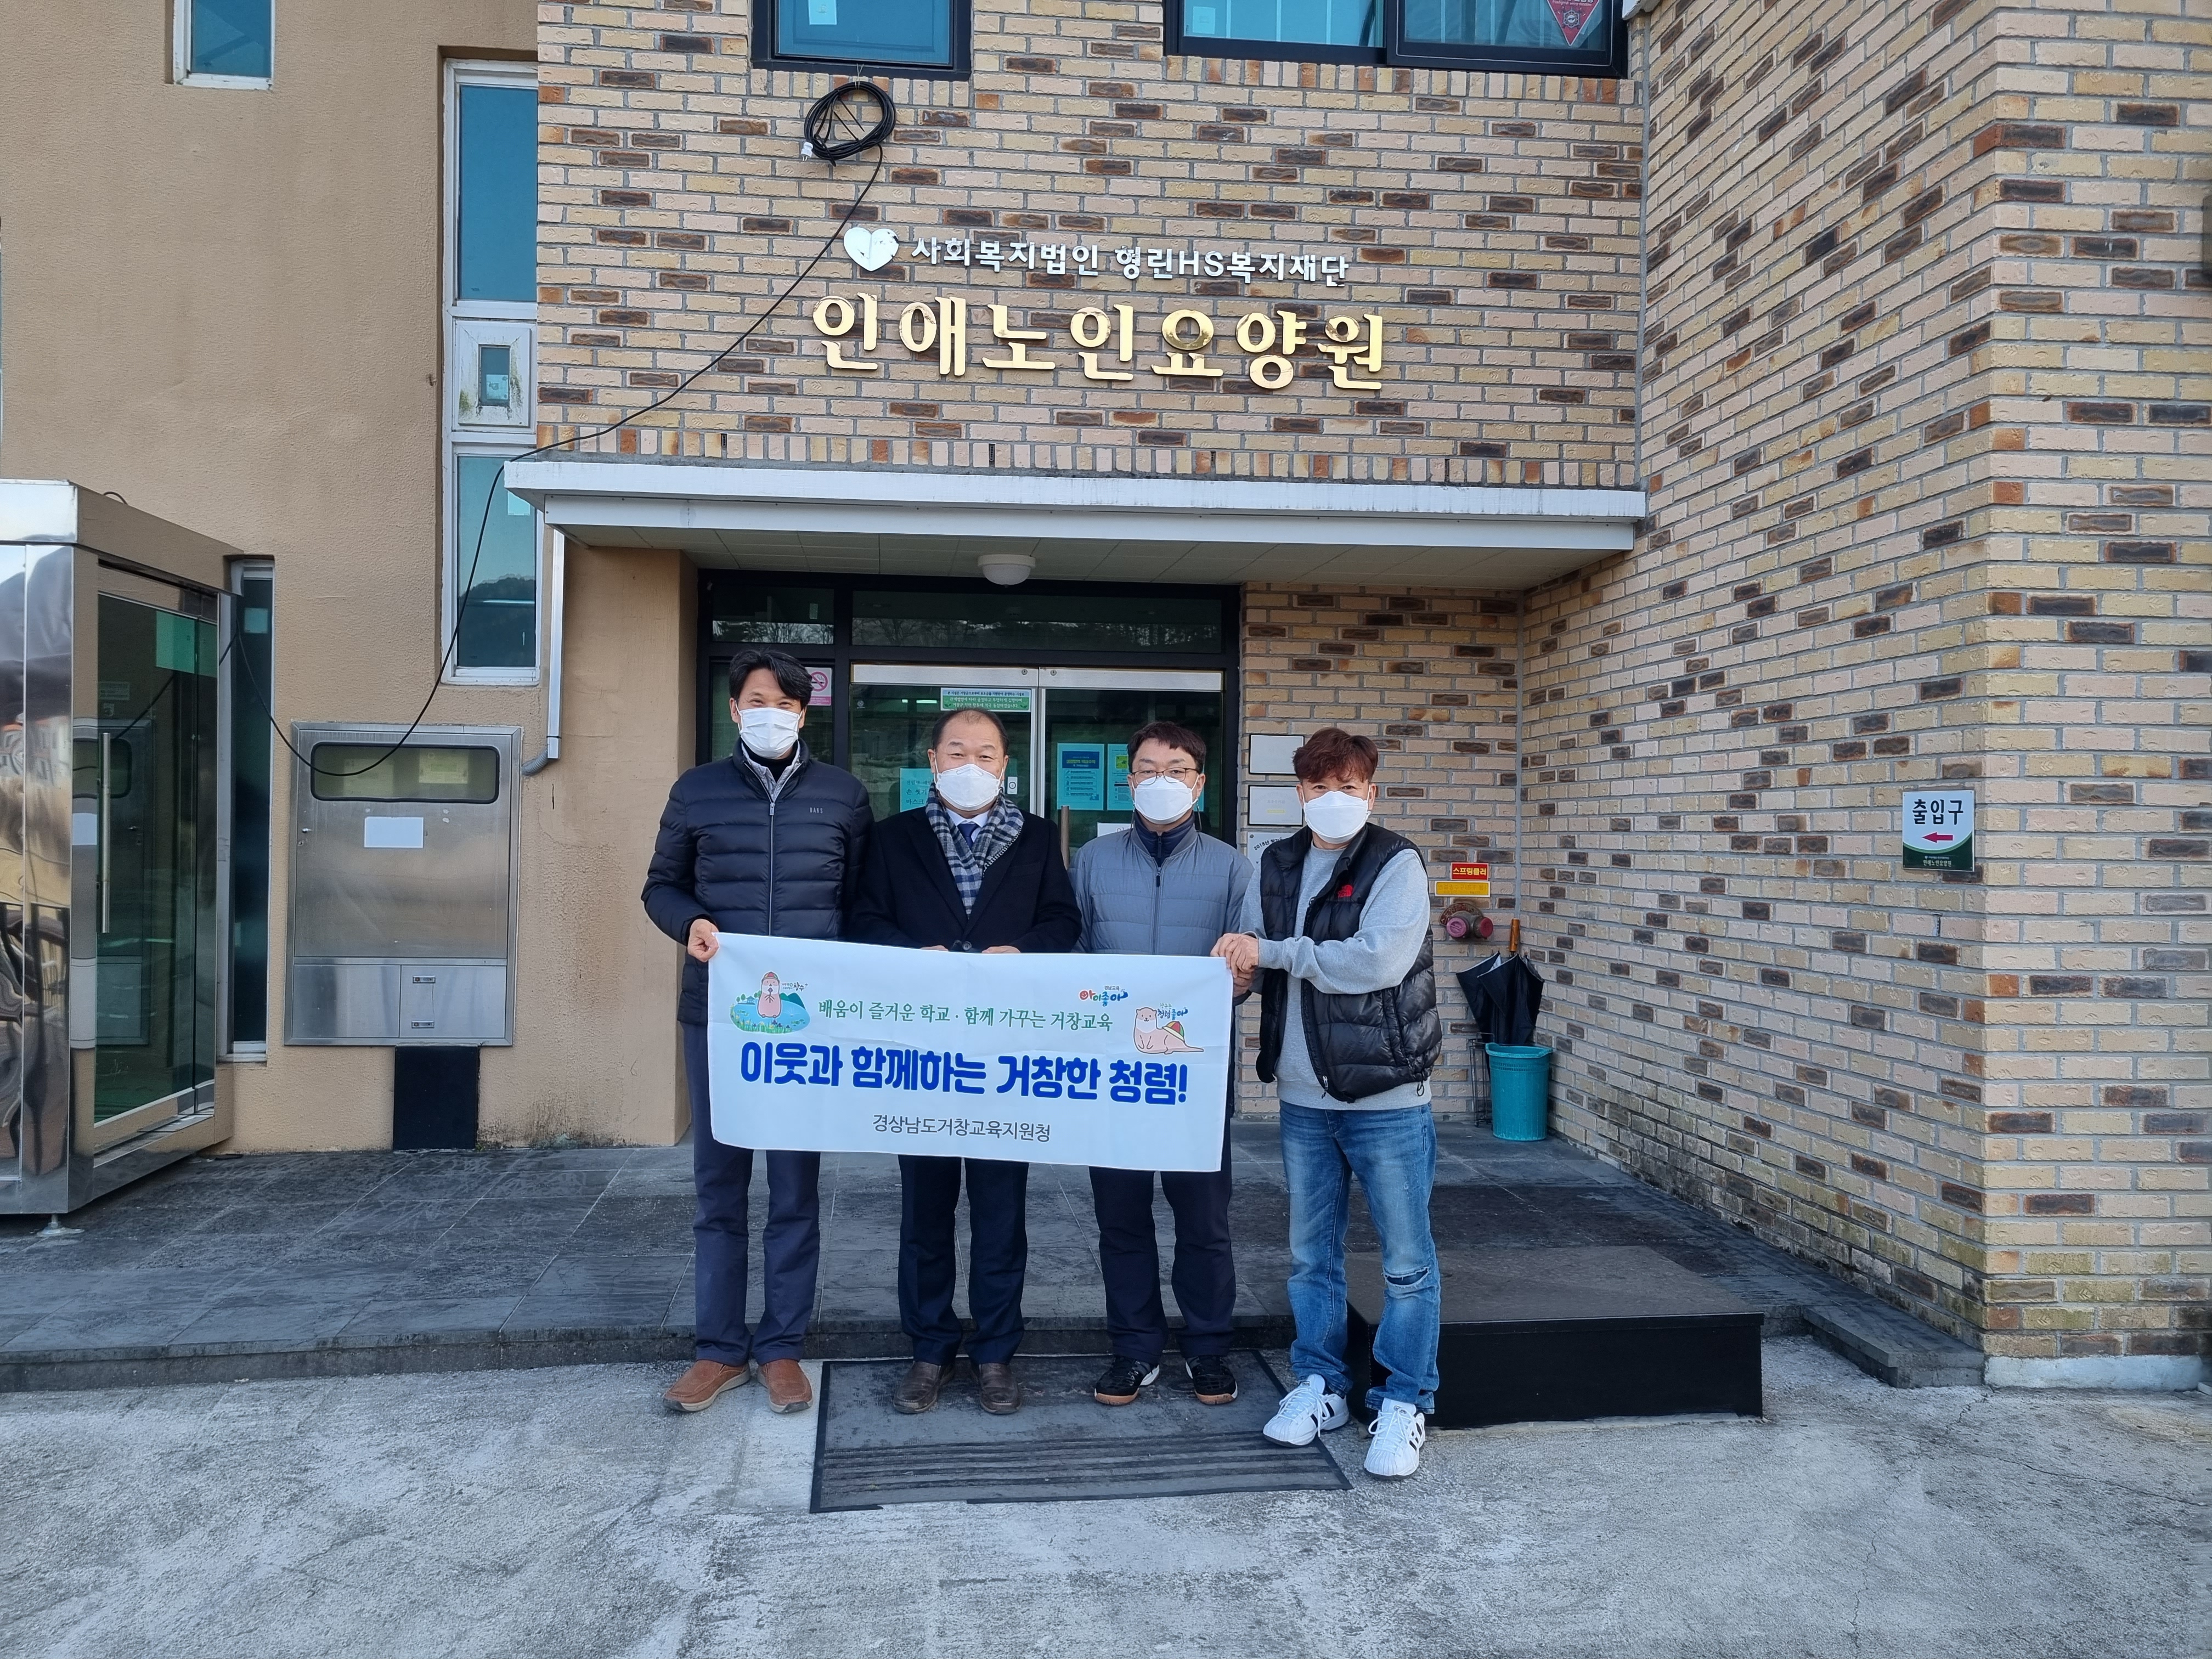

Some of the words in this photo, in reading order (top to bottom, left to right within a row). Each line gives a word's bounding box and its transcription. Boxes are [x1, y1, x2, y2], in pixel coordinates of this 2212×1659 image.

[911, 239, 1098, 276] 사회복지법인
[1114, 245, 1349, 288] 형린HS복지재단
[812, 292, 1383, 390] 인애노인요양원
[1912, 799, 1964, 826] 출입구
[1254, 840, 1270, 850] 2018년
[1079, 990, 1128, 1007] 아이좋아
[818, 998, 863, 1020] 배움이
[868, 1001, 916, 1022] 즐거운
[919, 1004, 950, 1023] 학교
[964, 1006, 994, 1026] 함께
[998, 1008, 1046, 1028] 가꾸는
[1050, 1011, 1113, 1032] 거창교육
[1157, 1007, 1188, 1020] 청렴좋아
[741, 1041, 843, 1087] 이웃과
[850, 1045, 986, 1094] 함께하는
[996, 1054, 1102, 1101] 거창한
[1108, 1058, 1188, 1105] 청렴!
[872, 1114, 1051, 1143] 경상남도거창교육지원청
